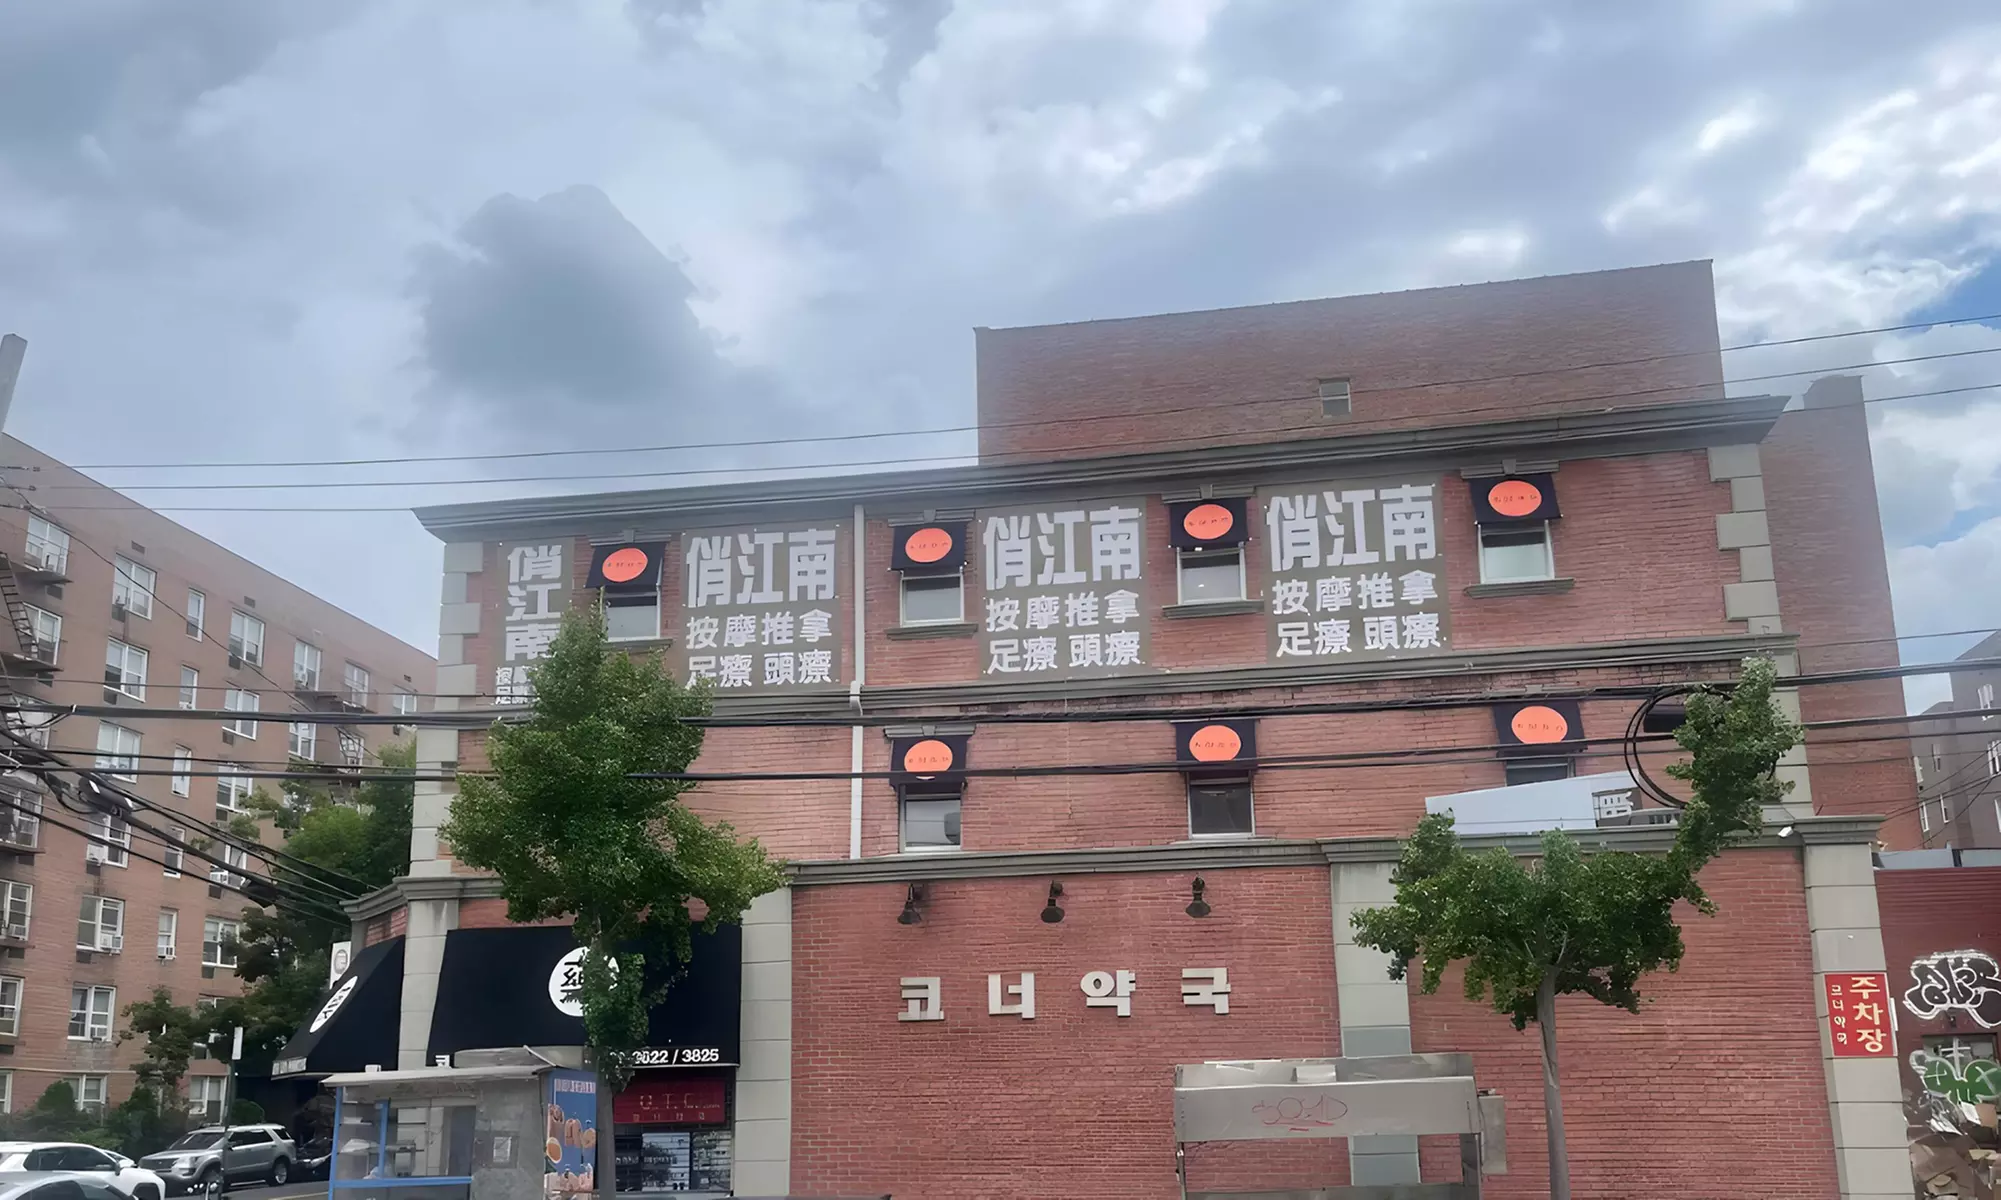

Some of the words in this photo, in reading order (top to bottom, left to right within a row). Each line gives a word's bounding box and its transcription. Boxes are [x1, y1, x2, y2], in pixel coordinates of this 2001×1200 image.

[983, 506, 1140, 590] 俏江南
[1266, 484, 1436, 572] 俏江南
[686, 528, 836, 608] 俏江南
[1272, 569, 1438, 615] 按摩推拿
[686, 608, 832, 649] 按摩推拿
[985, 589, 1140, 632] 按摩推拿
[1850, 976, 1887, 1053] 주차장
[682, 1048, 720, 1062] 3825
